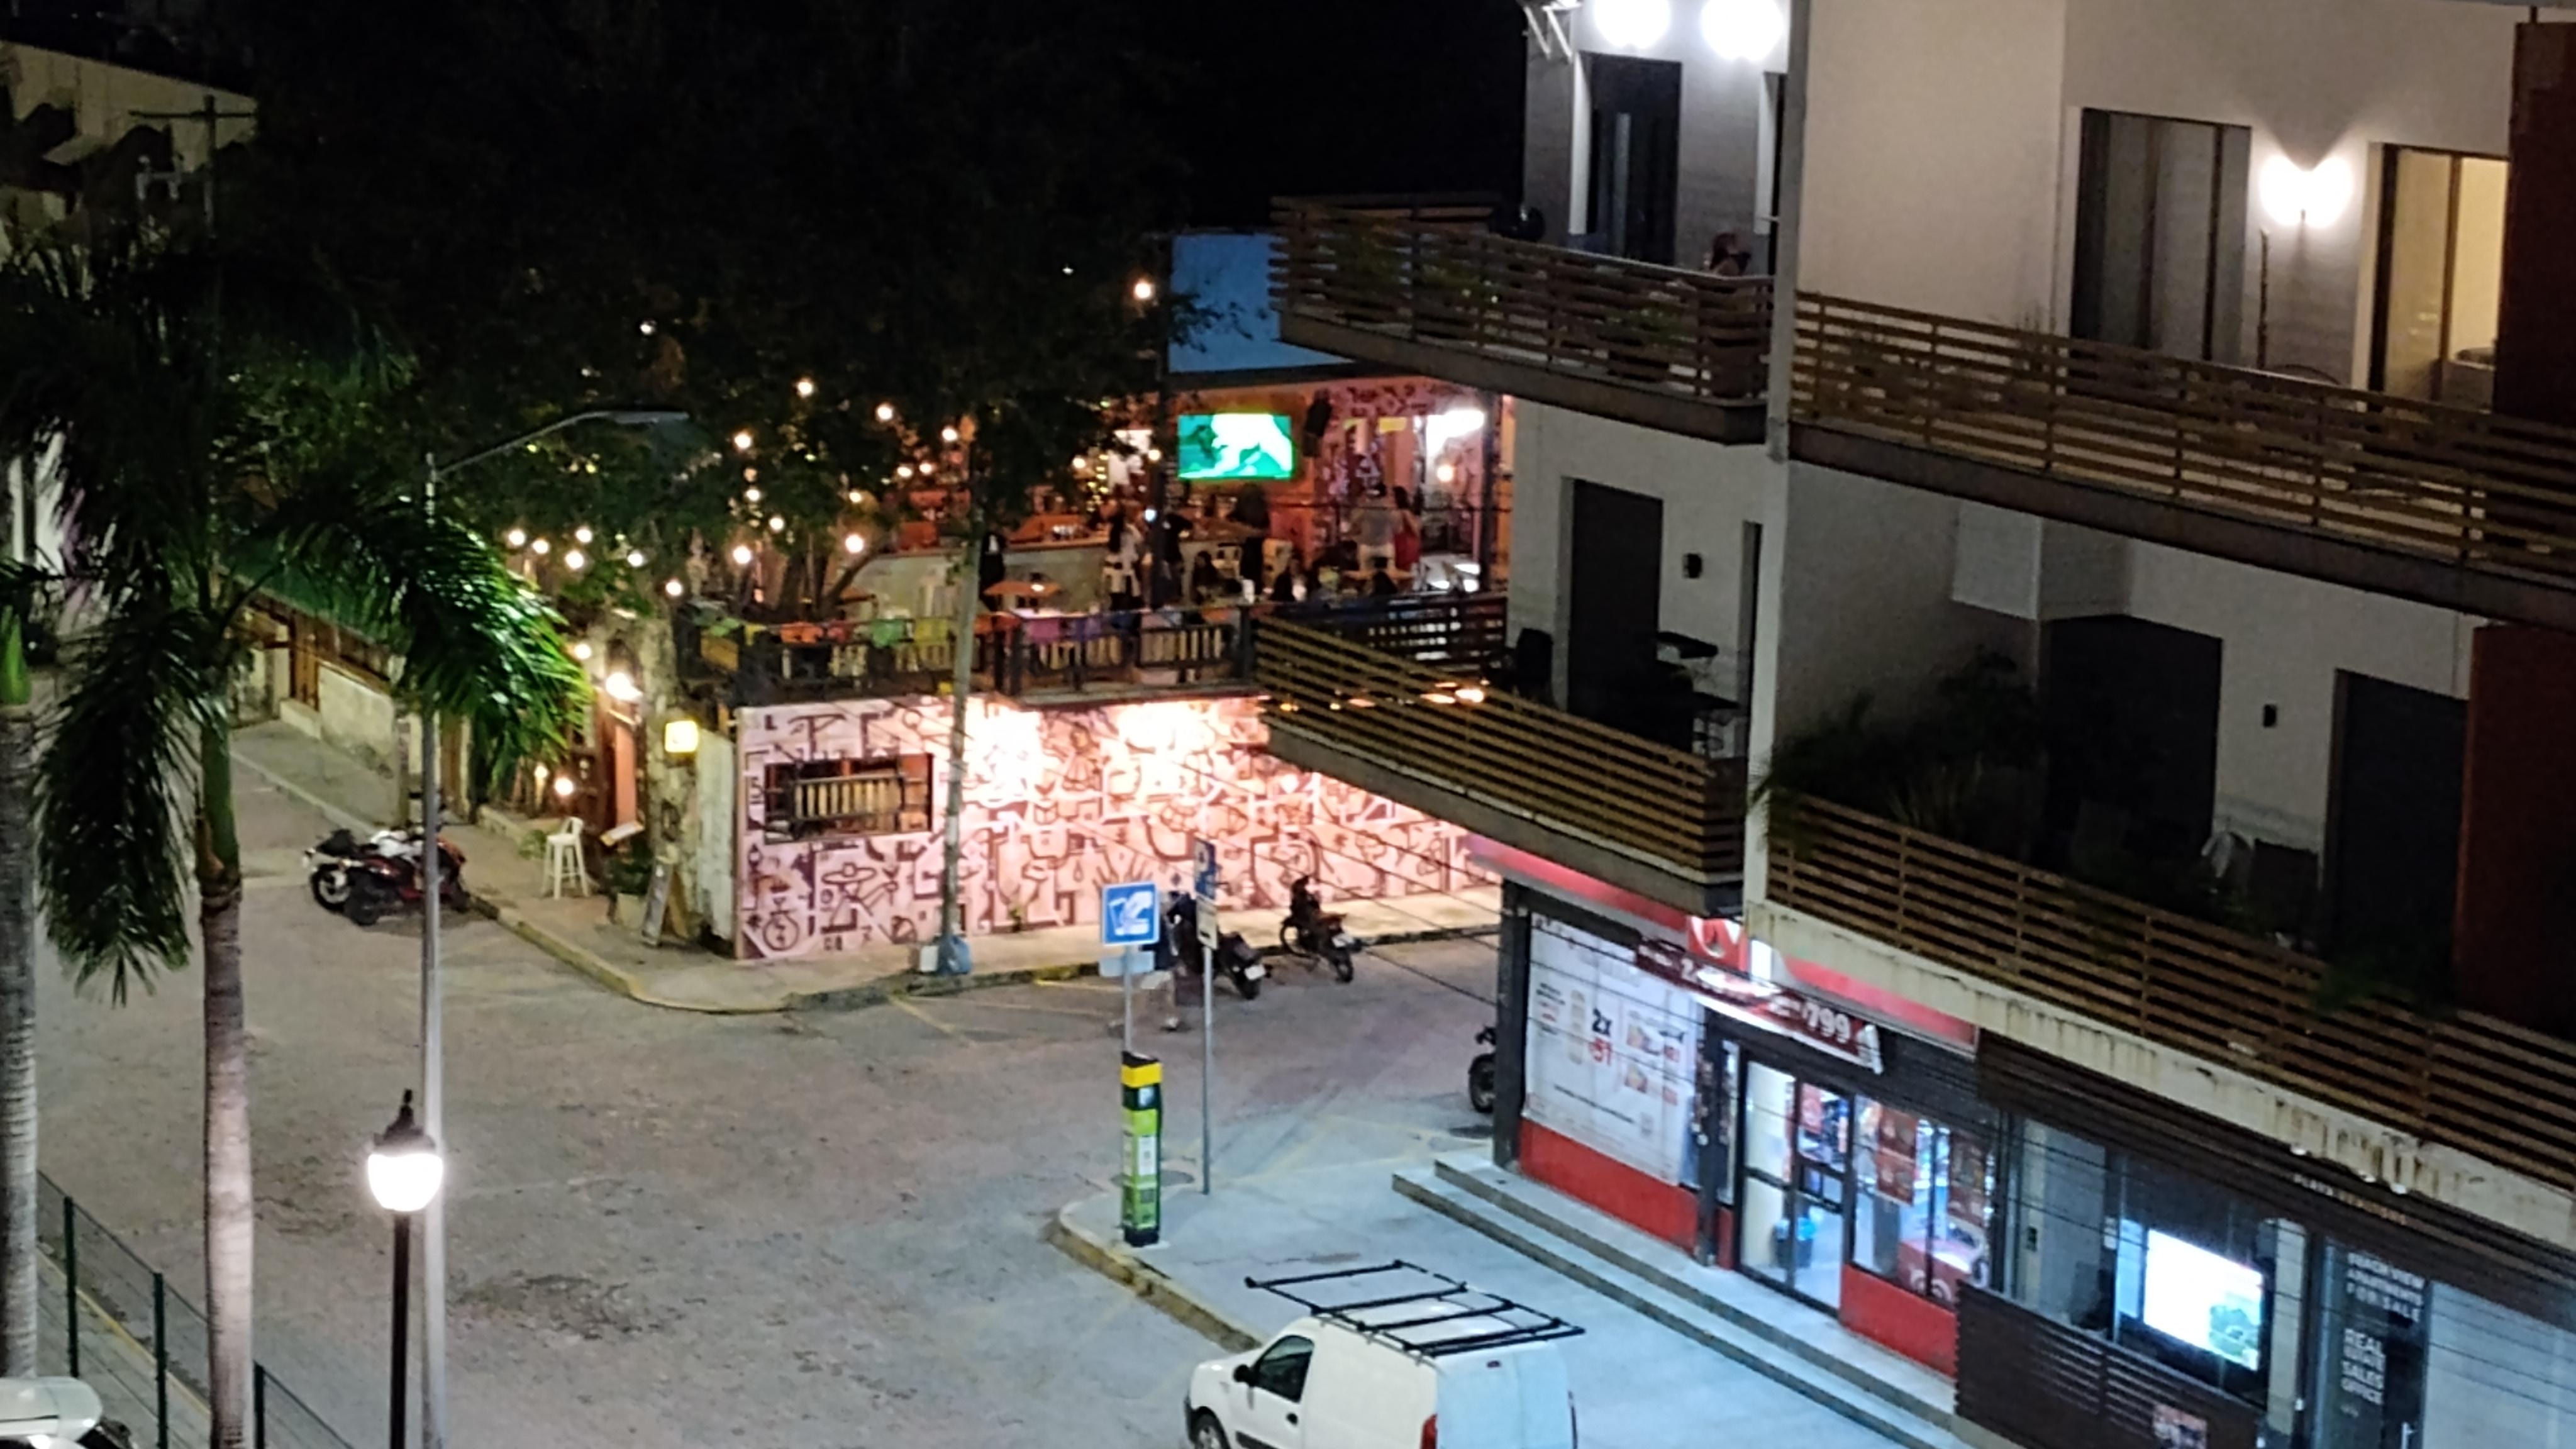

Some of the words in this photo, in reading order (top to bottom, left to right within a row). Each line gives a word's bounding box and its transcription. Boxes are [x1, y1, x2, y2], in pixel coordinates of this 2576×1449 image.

[2346, 1282, 2378, 1305] FOR
[2382, 1296, 2419, 1323] SALE
[2344, 1328, 2386, 1359] REAL
[2342, 1360, 2384, 1389] SALES
